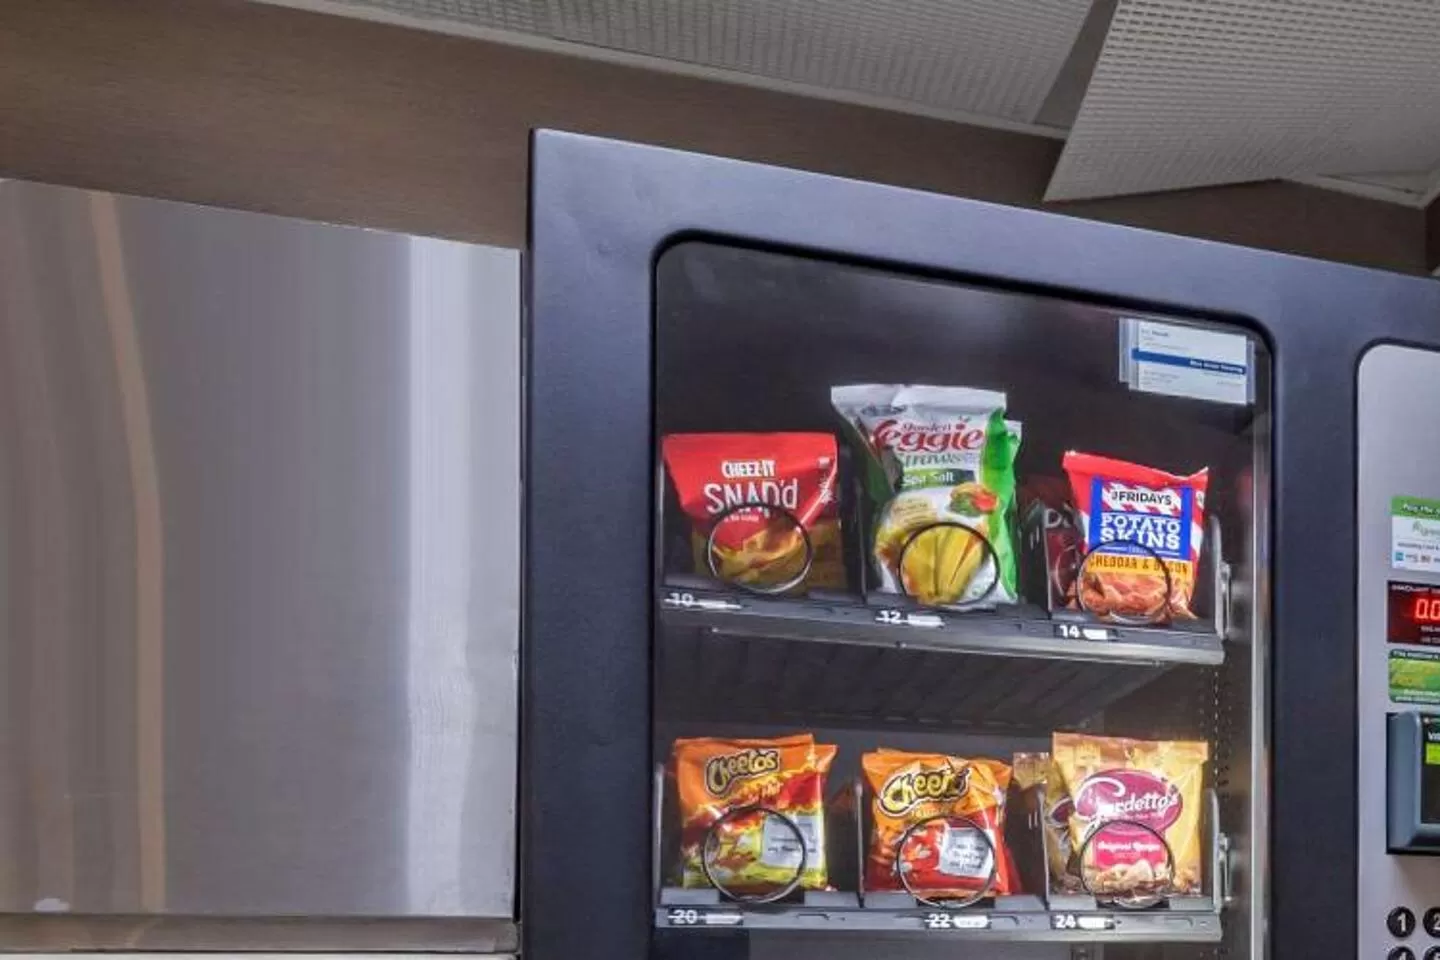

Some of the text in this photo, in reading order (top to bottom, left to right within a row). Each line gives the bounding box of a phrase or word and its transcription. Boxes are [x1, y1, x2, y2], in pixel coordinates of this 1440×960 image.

[1101, 514, 1181, 535] POTATO
[1101, 527, 1181, 550] SKINS
[1059, 624, 1080, 638] 14
[707, 750, 780, 797] Cheetos
[882, 768, 970, 814] Cheet
[1055, 914, 1077, 929] 24
[1397, 912, 1407, 933] 1
